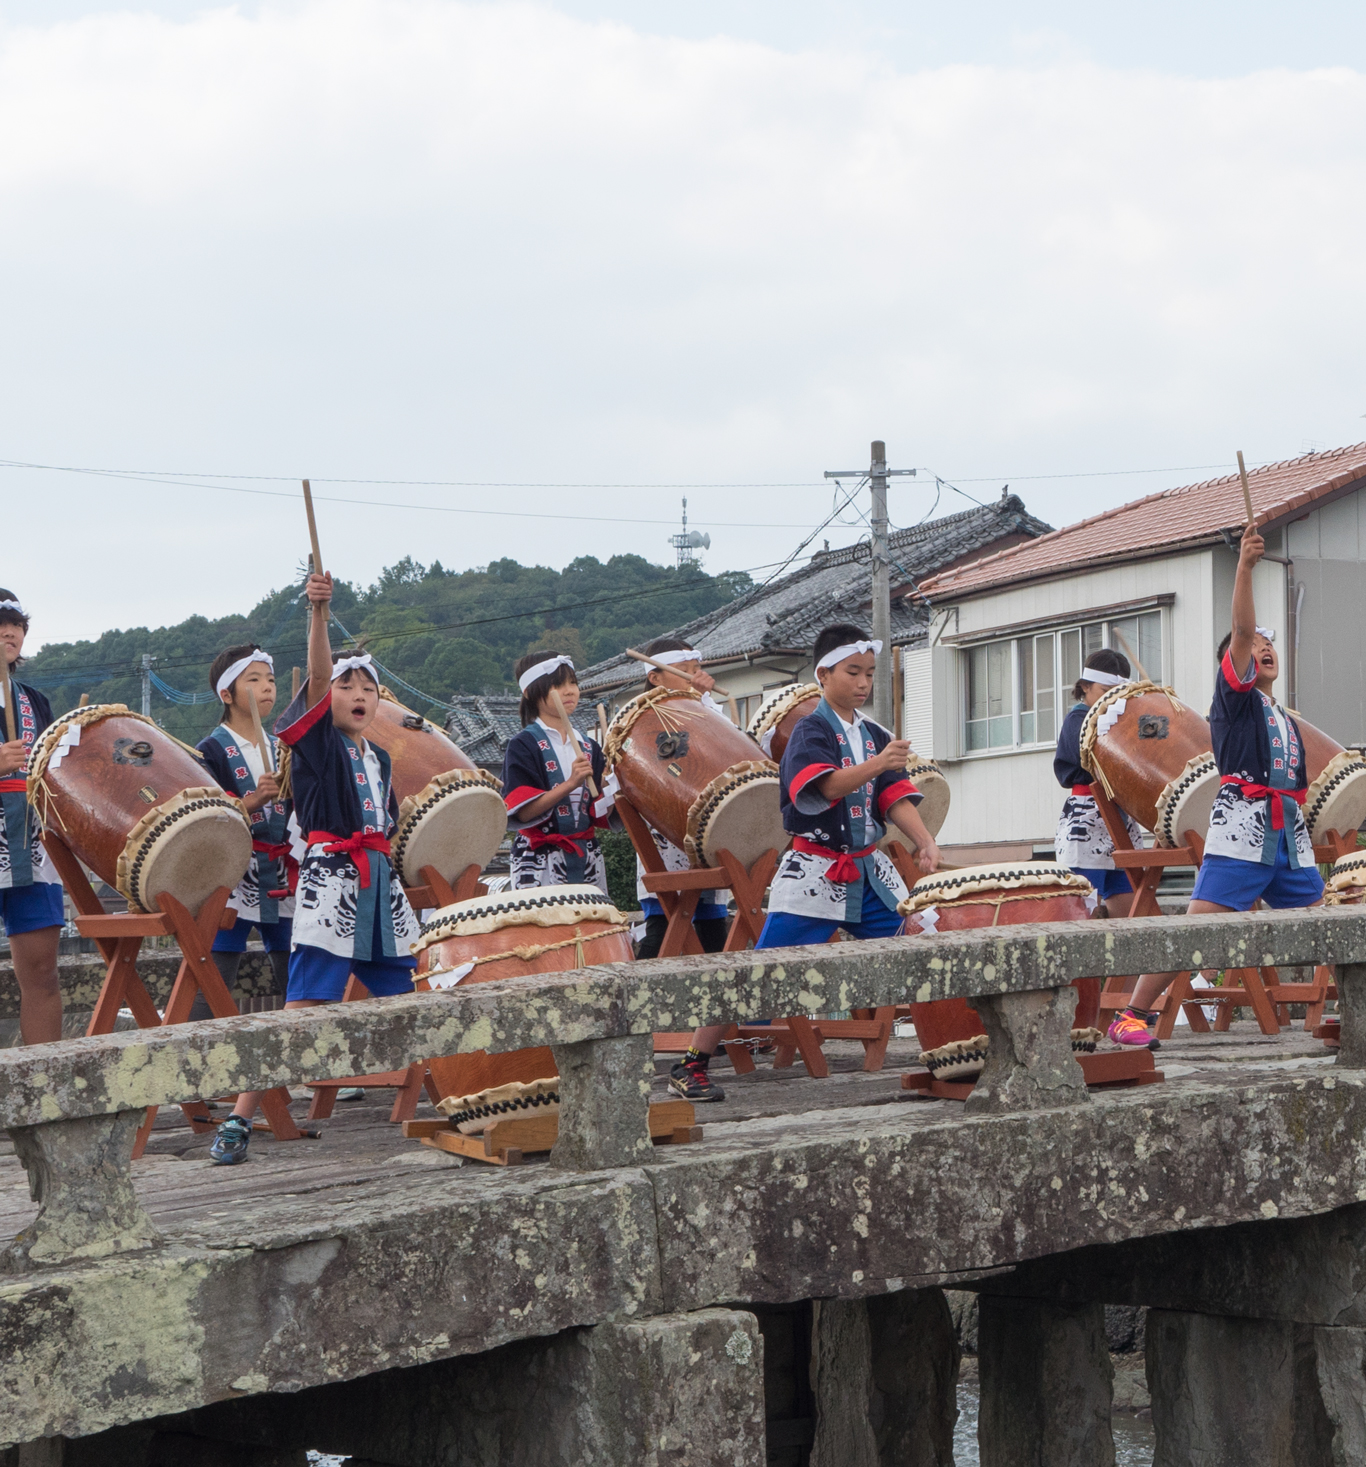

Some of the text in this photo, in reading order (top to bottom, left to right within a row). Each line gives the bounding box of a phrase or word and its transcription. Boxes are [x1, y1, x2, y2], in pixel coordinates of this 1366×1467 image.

[537, 739, 571, 817] 天草鼓
[835, 733, 864, 819] 天草鼓
